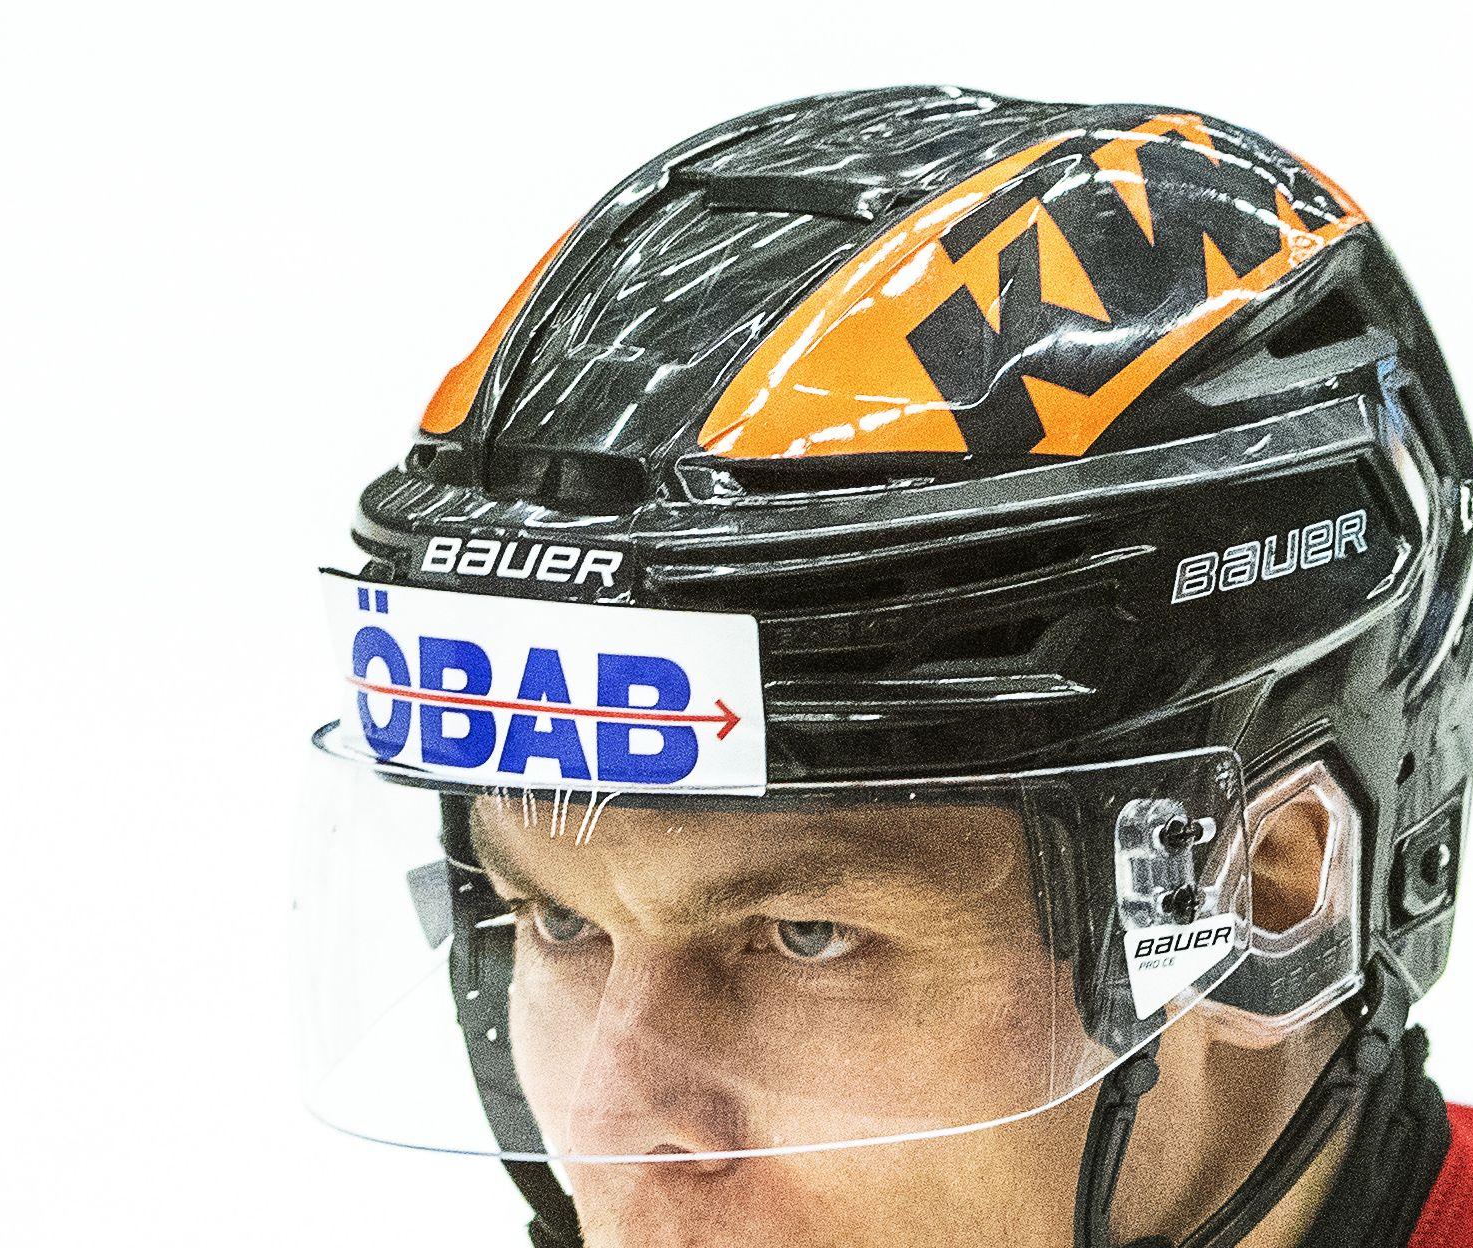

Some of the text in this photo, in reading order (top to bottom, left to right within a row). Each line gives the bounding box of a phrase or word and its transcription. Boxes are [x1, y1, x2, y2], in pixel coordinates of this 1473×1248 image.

[420, 535, 625, 588] BAUER
[1170, 508, 1369, 604] BAUER
[351, 587, 700, 786] ÖBAB
[1134, 925, 1233, 961] BAUER
